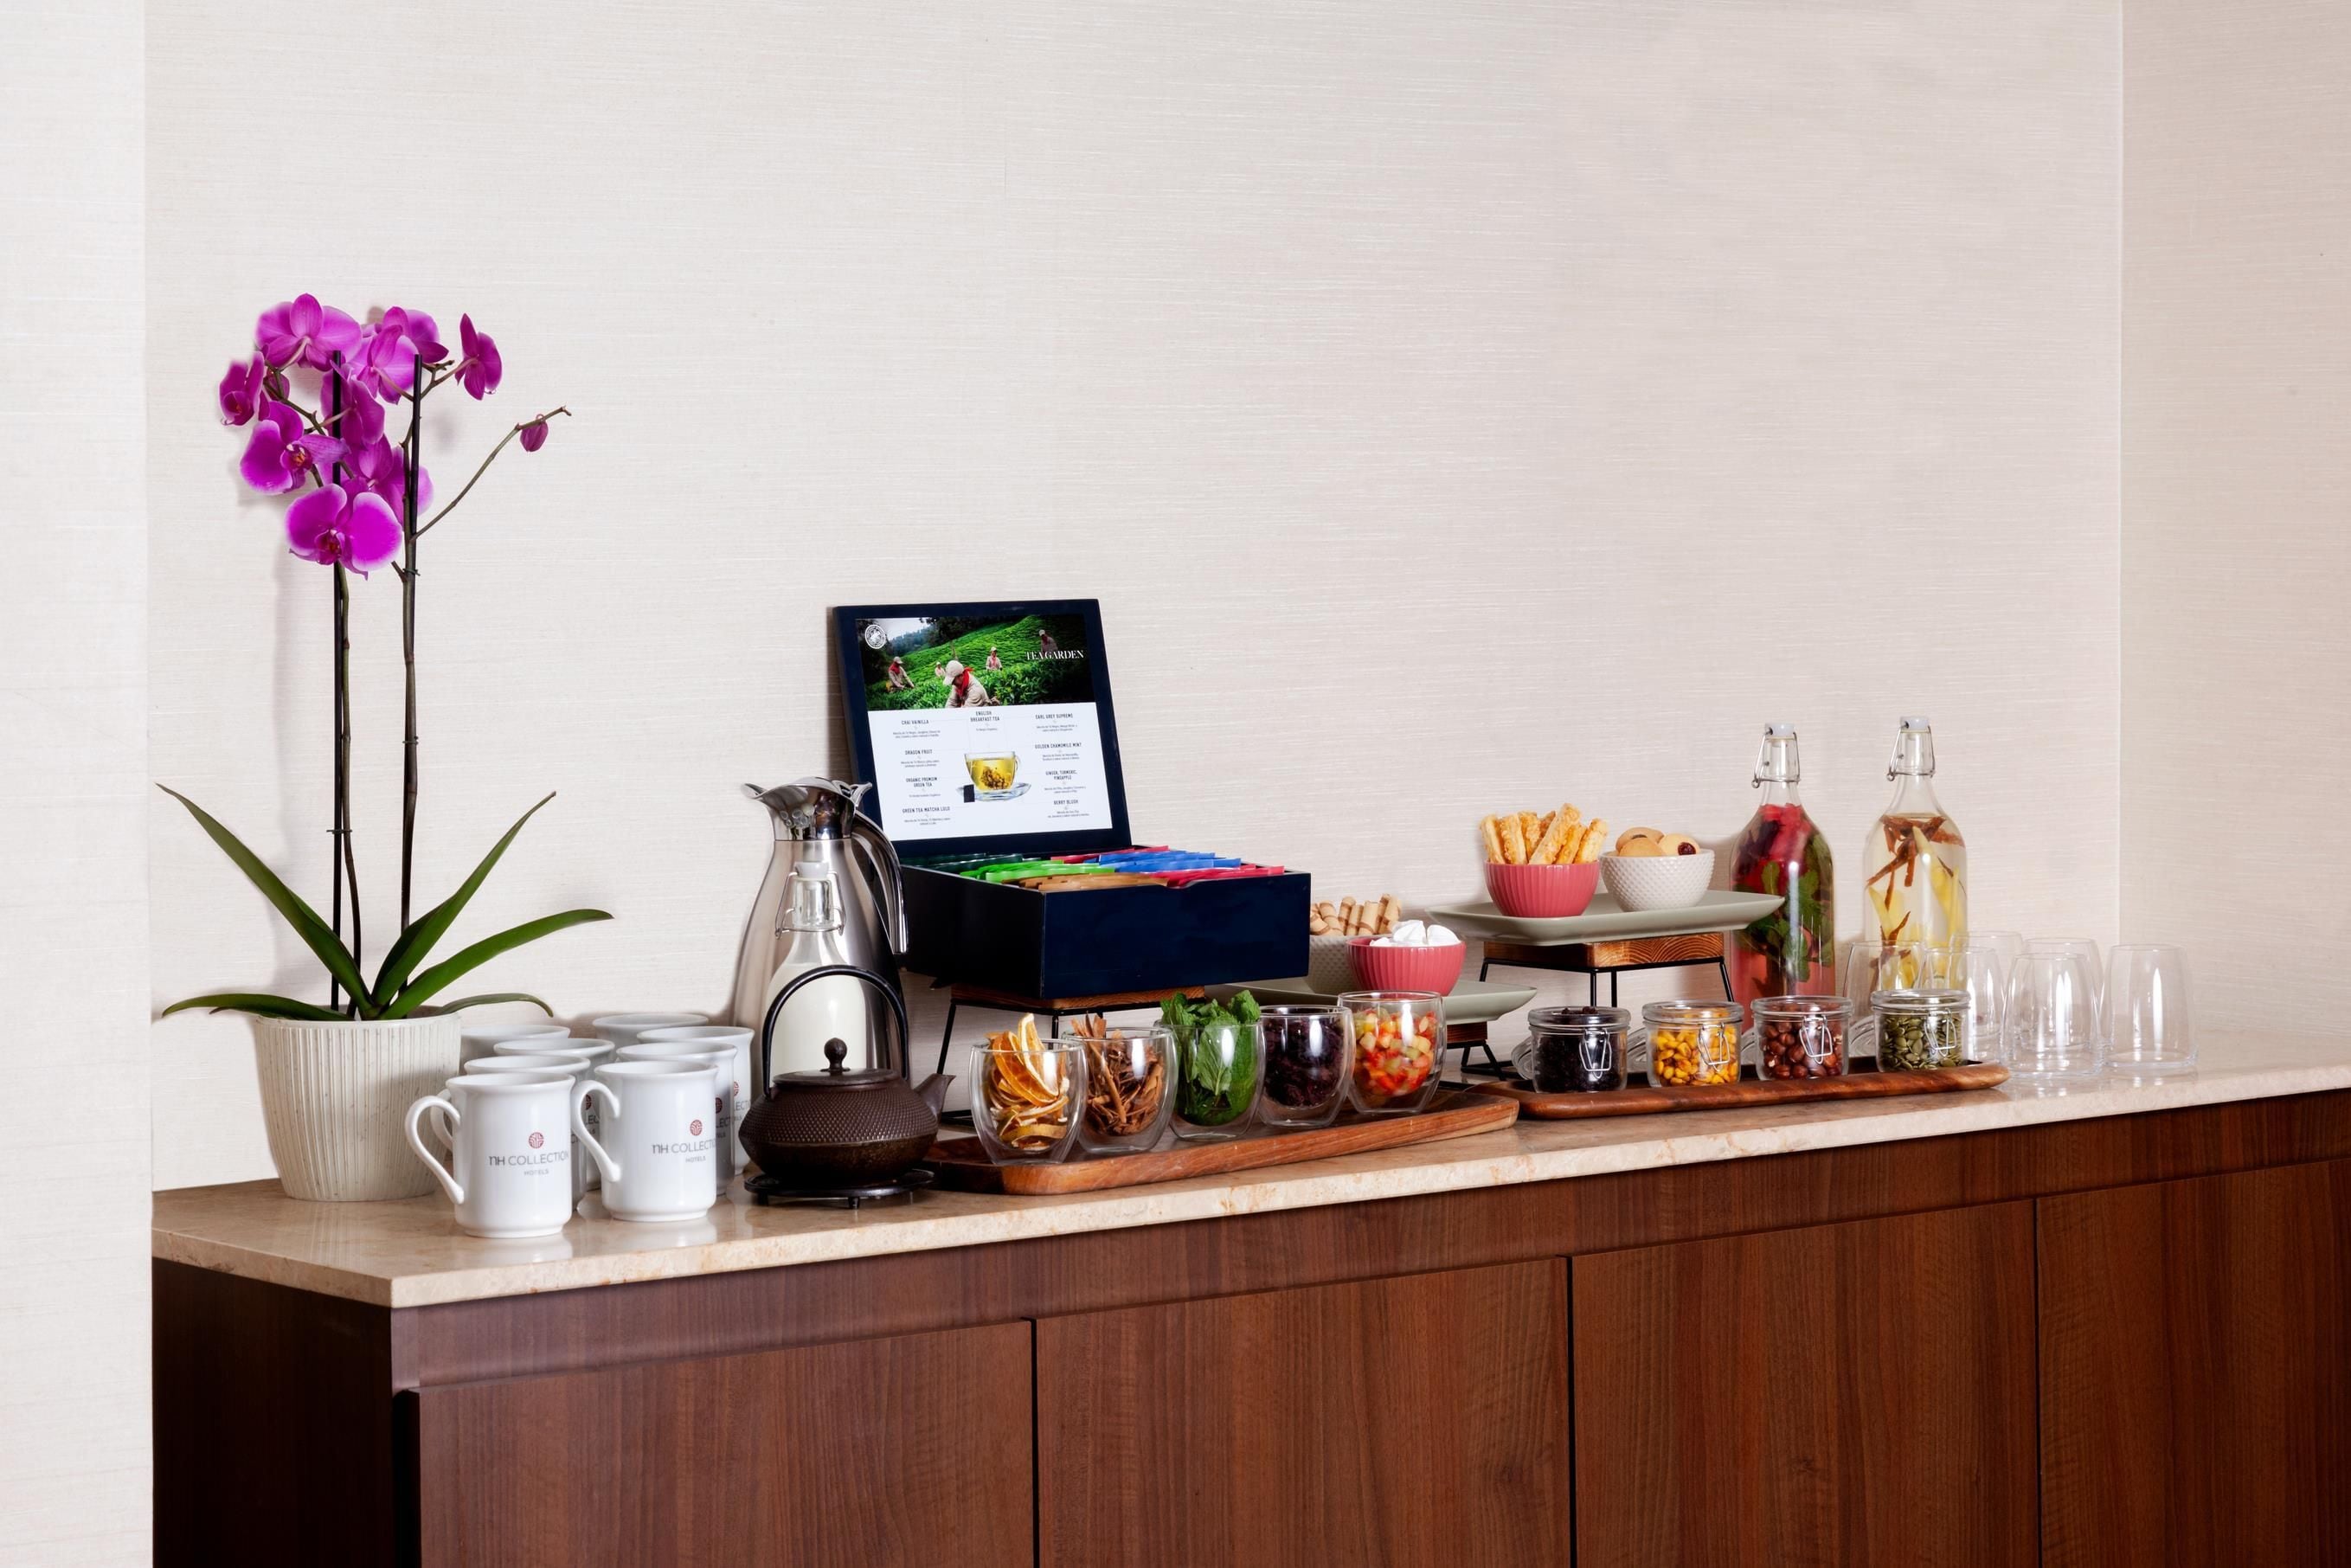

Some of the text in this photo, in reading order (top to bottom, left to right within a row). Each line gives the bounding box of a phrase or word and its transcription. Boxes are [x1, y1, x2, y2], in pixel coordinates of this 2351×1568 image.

[1025, 650, 1084, 660] TEA GARDEN
[671, 1138, 716, 1154] COLLECTI
